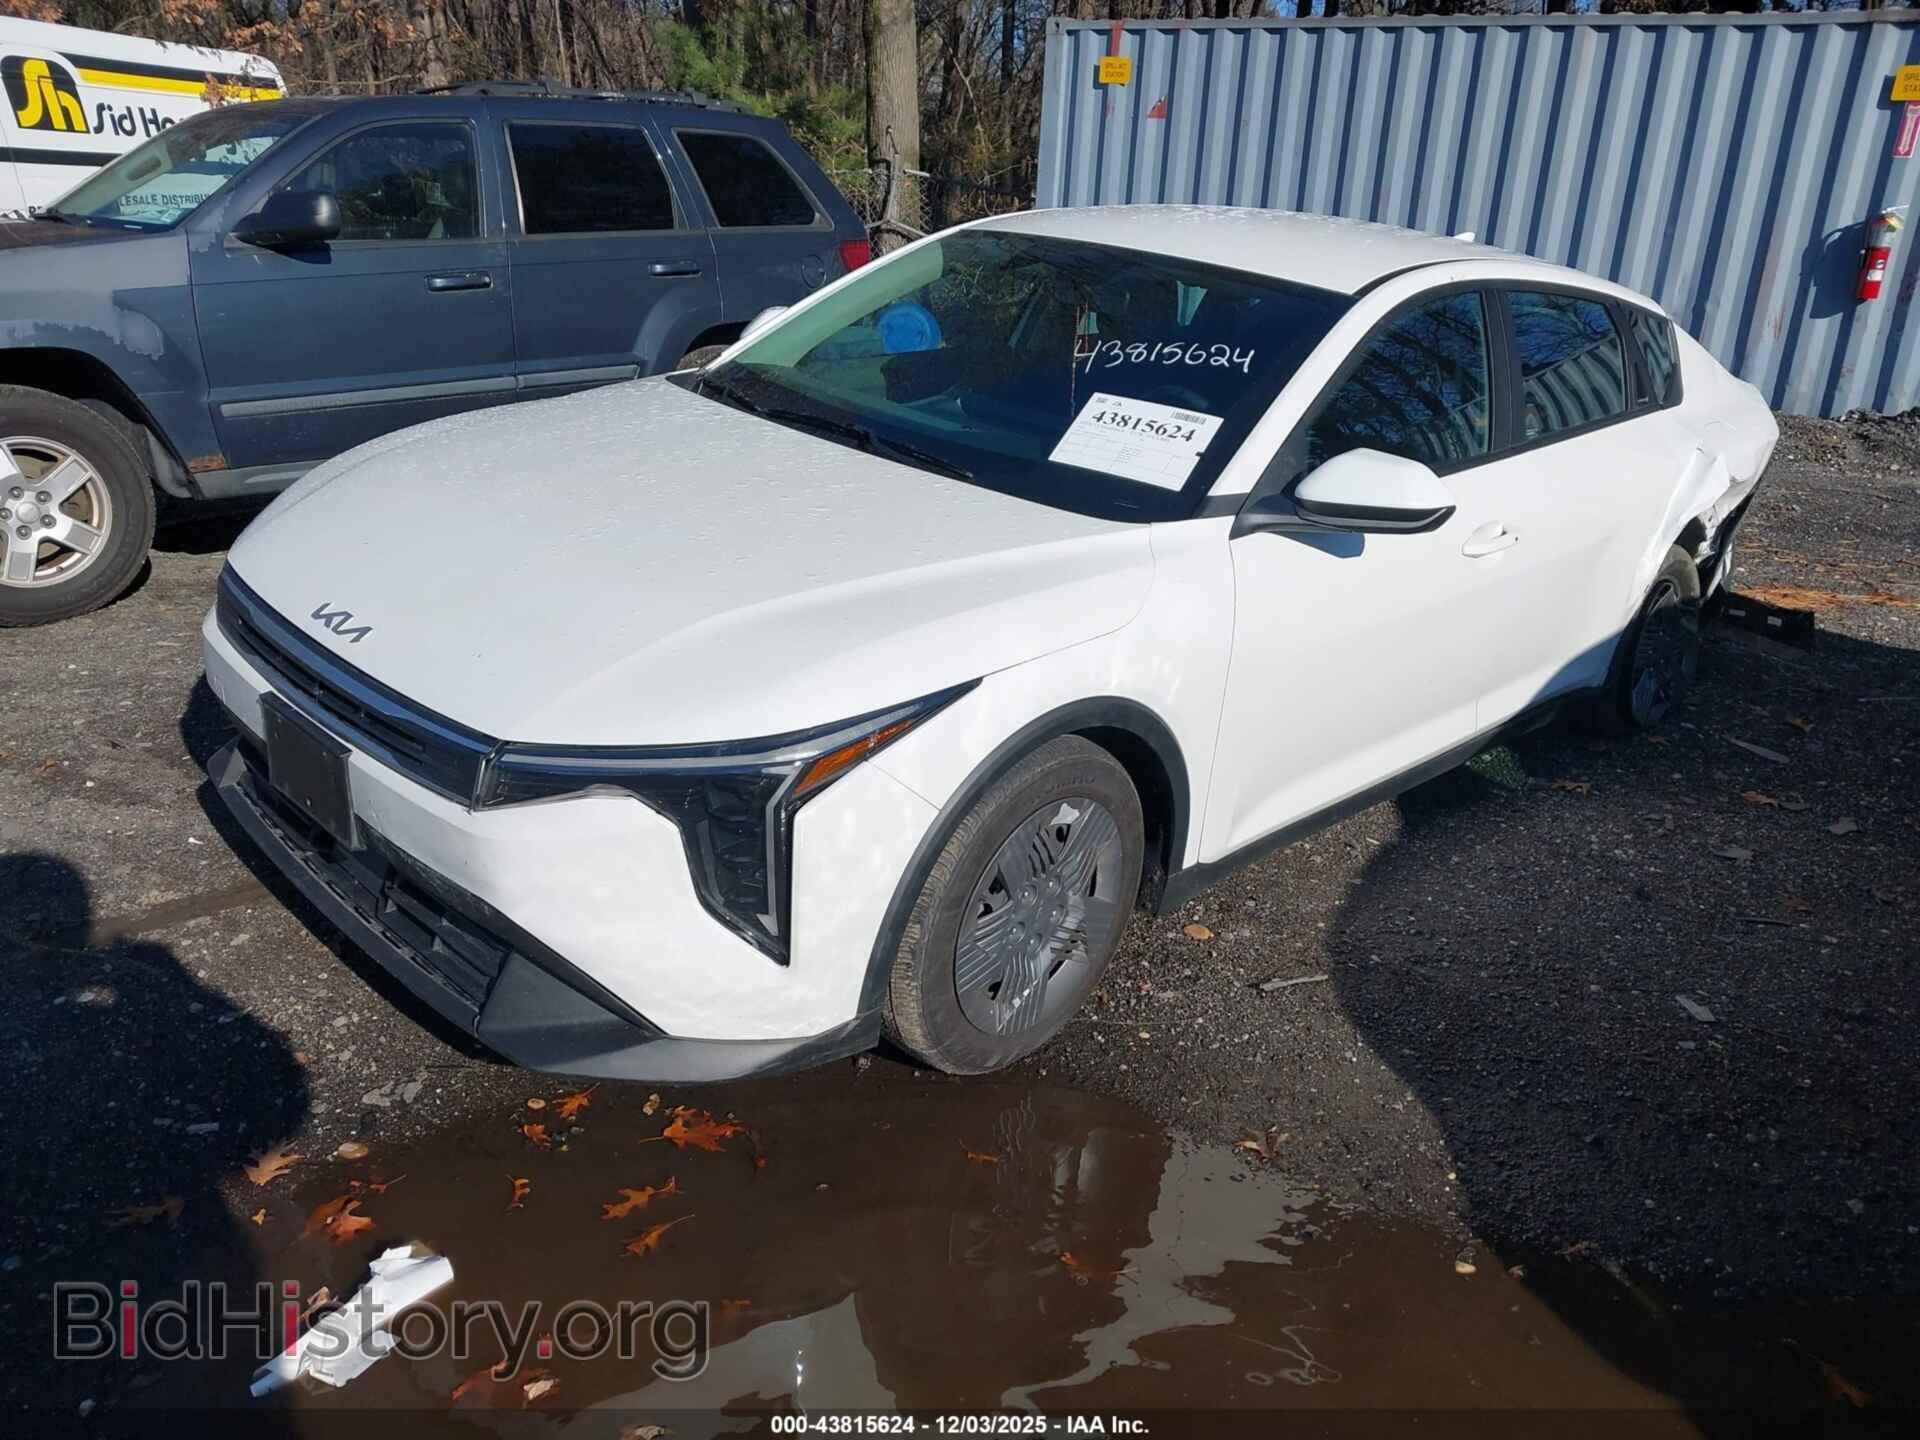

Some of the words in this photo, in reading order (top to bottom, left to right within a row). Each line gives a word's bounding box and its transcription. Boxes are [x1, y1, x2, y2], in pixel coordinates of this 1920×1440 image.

[93, 103, 137, 136] Sid
[1074, 339, 1255, 374] 43815624
[1092, 410, 1197, 442] 43815624
[310, 602, 373, 643] KIA
